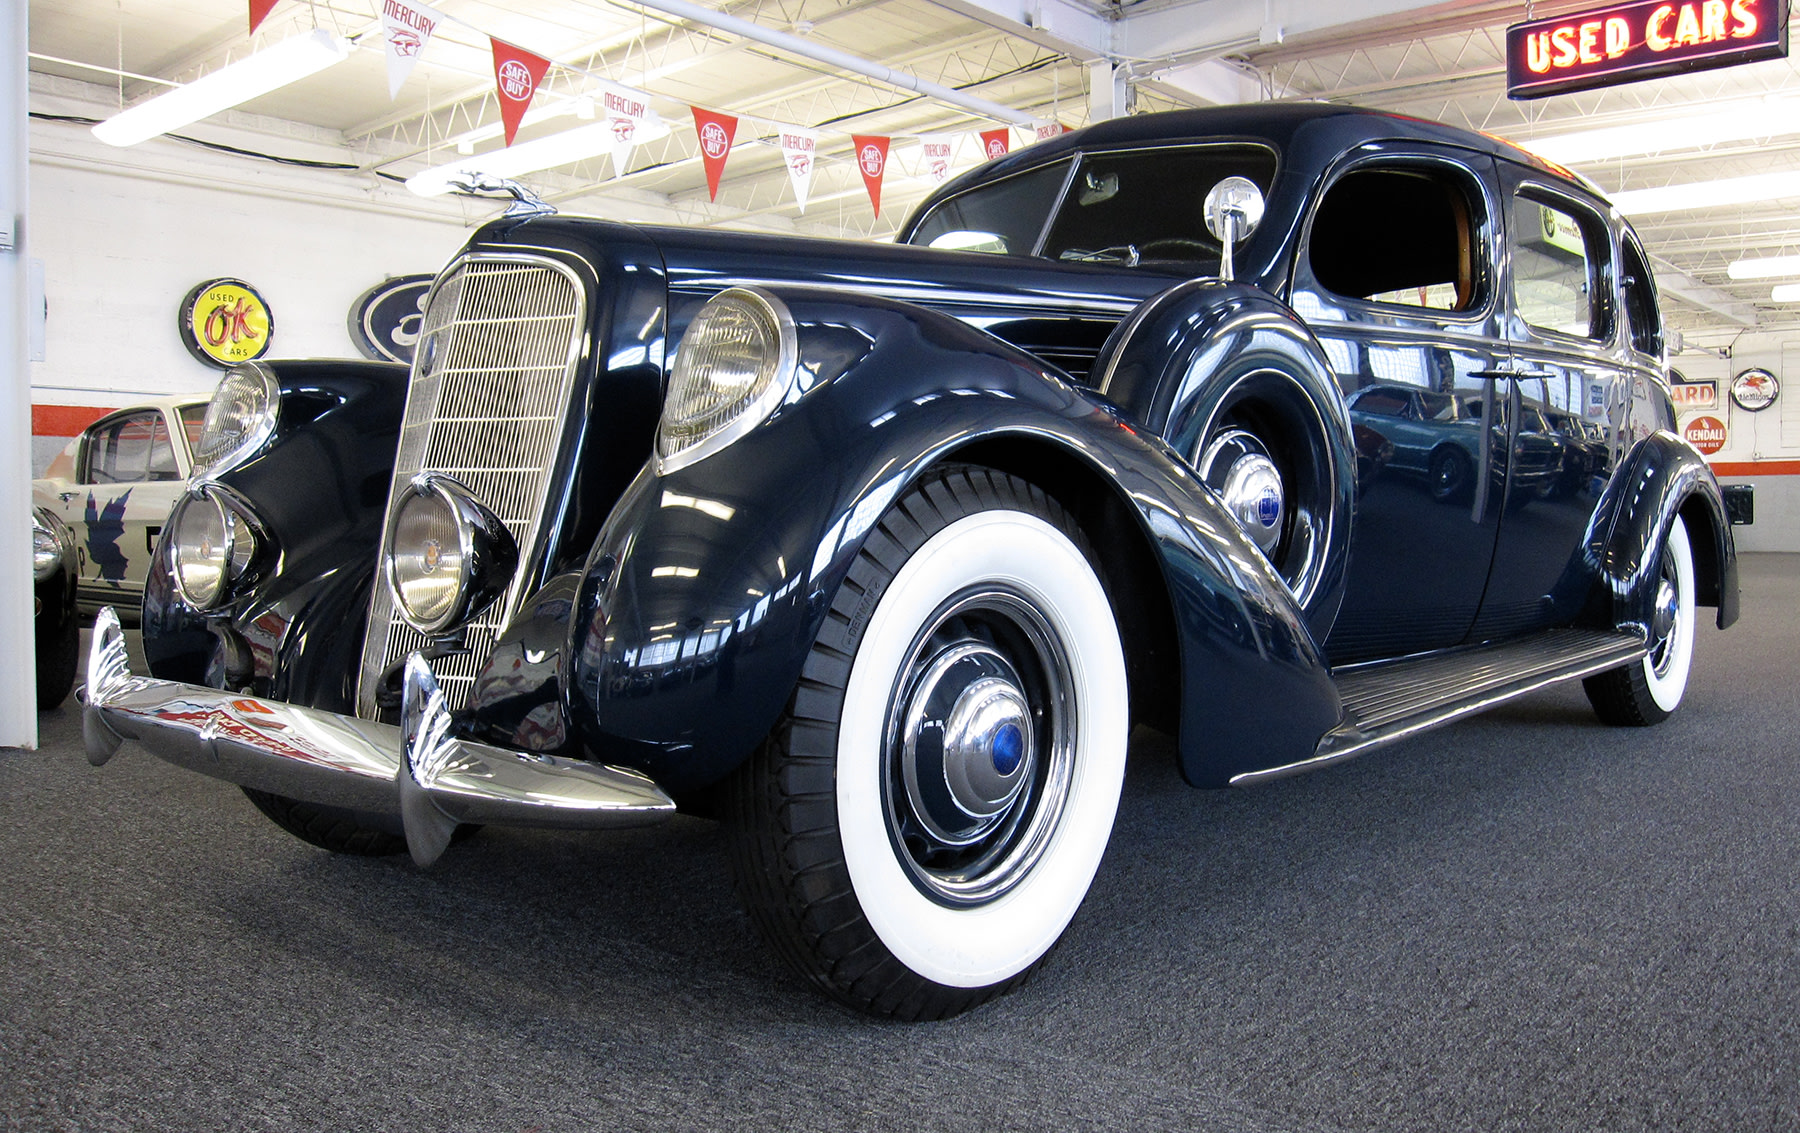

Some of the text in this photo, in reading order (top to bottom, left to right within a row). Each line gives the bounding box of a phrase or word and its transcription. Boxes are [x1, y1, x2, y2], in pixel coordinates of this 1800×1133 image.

[383, 0, 436, 37] MERCURY
[1527, 0, 1757, 73] USED CARS
[505, 63, 528, 84] SAFE
[506, 80, 525, 97] BUY
[604, 92, 645, 118] MERCURY
[705, 126, 722, 141] SAFE
[706, 141, 721, 154] BUY
[783, 134, 815, 152] MERCURY
[924, 144, 951, 157] MERCURY
[864, 149, 879, 161] SAFE
[866, 161, 878, 173] BUY
[210, 293, 234, 302] USED
[204, 297, 258, 346] OK
[224, 348, 248, 356] CARS
[1687, 429, 1724, 441] KENDALL
[848, 588, 877, 637] DENMAN
